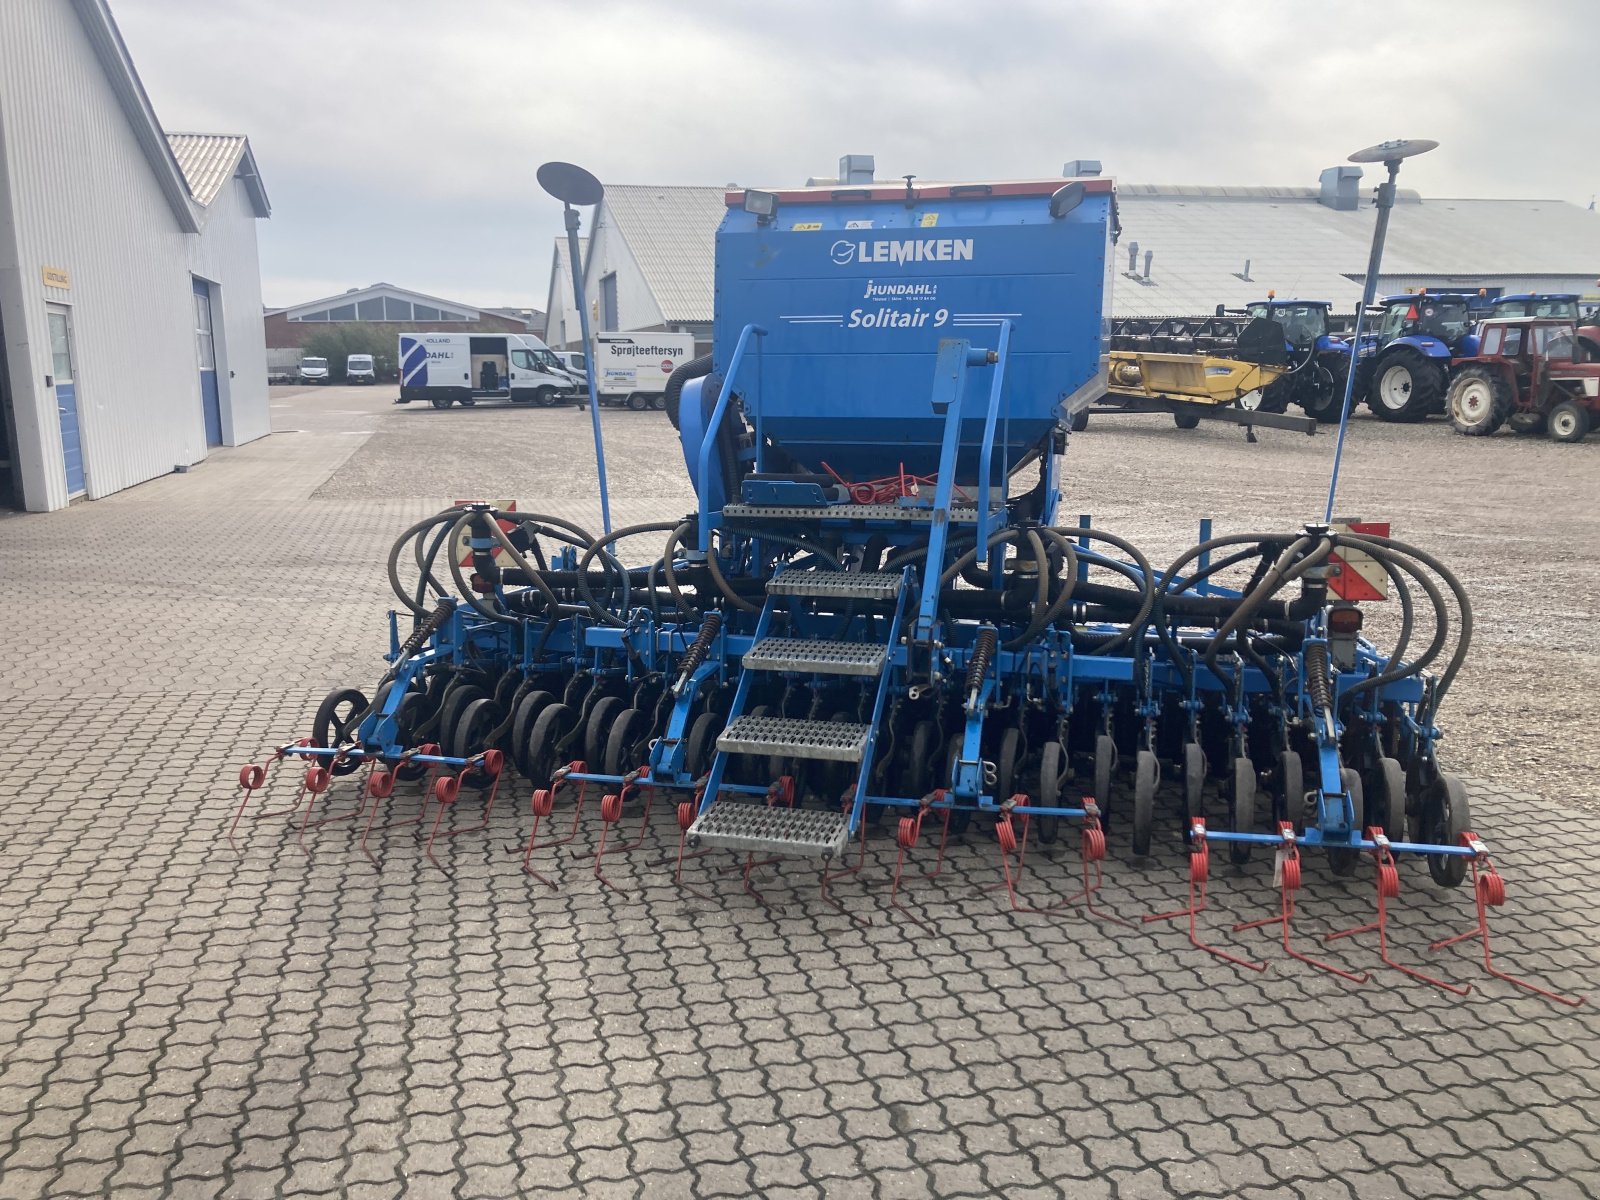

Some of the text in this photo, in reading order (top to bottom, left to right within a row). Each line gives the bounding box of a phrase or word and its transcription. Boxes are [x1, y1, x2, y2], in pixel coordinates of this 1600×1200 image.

[858, 239, 974, 266] LEMKEN
[848, 308, 949, 328] Solitair 9
[611, 345, 684, 357] Sprøjteeftersyn
